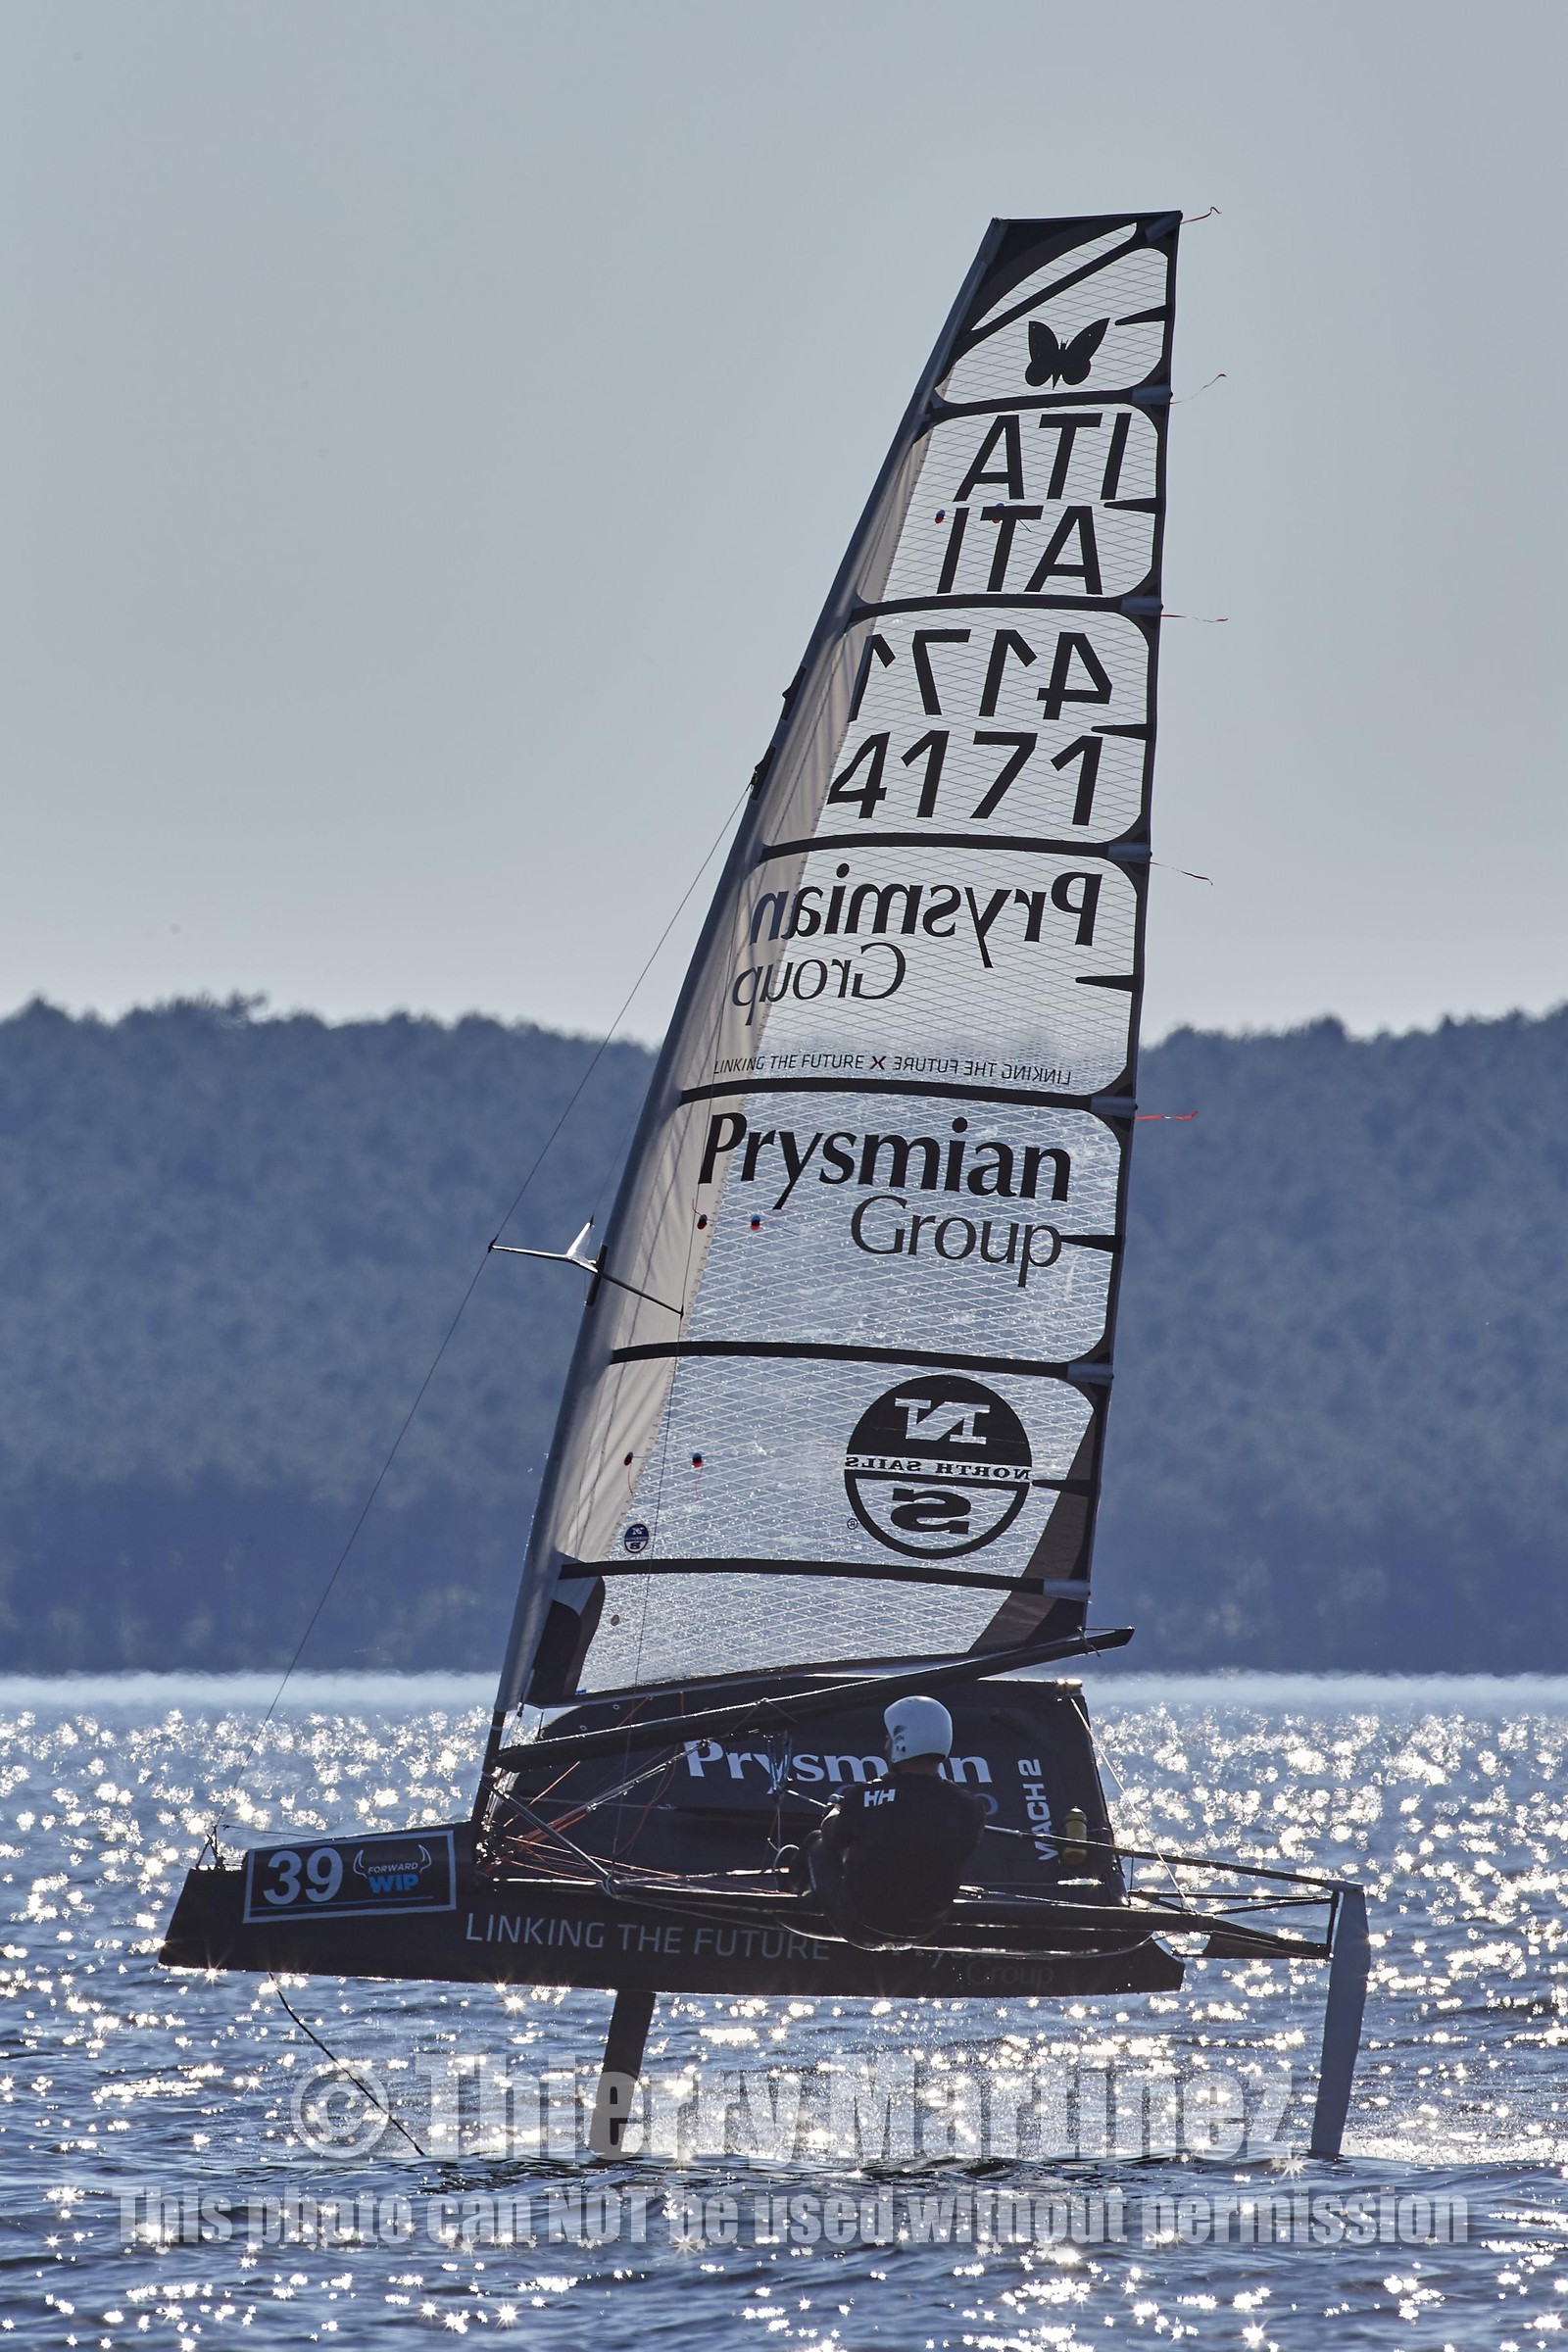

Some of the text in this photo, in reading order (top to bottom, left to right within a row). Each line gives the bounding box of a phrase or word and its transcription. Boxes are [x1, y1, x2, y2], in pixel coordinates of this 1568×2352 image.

[936, 505, 1103, 595] ITA
[826, 730, 1103, 826] 4171
[713, 1054, 864, 1074] LINKING THE FUTURE
[698, 1111, 1071, 1209] Prysmian
[851, 1195, 1062, 1288] Group
[683, 1740, 993, 1795] Prysmn
[1017, 1758, 1043, 1777] 2
[262, 1846, 345, 1906] 39
[368, 1861, 418, 1874] FORWARD
[368, 1872, 419, 1893] WIP
[466, 1912, 831, 1961] LINKING THE FUTURE
[967, 1959, 1054, 1991] Group
